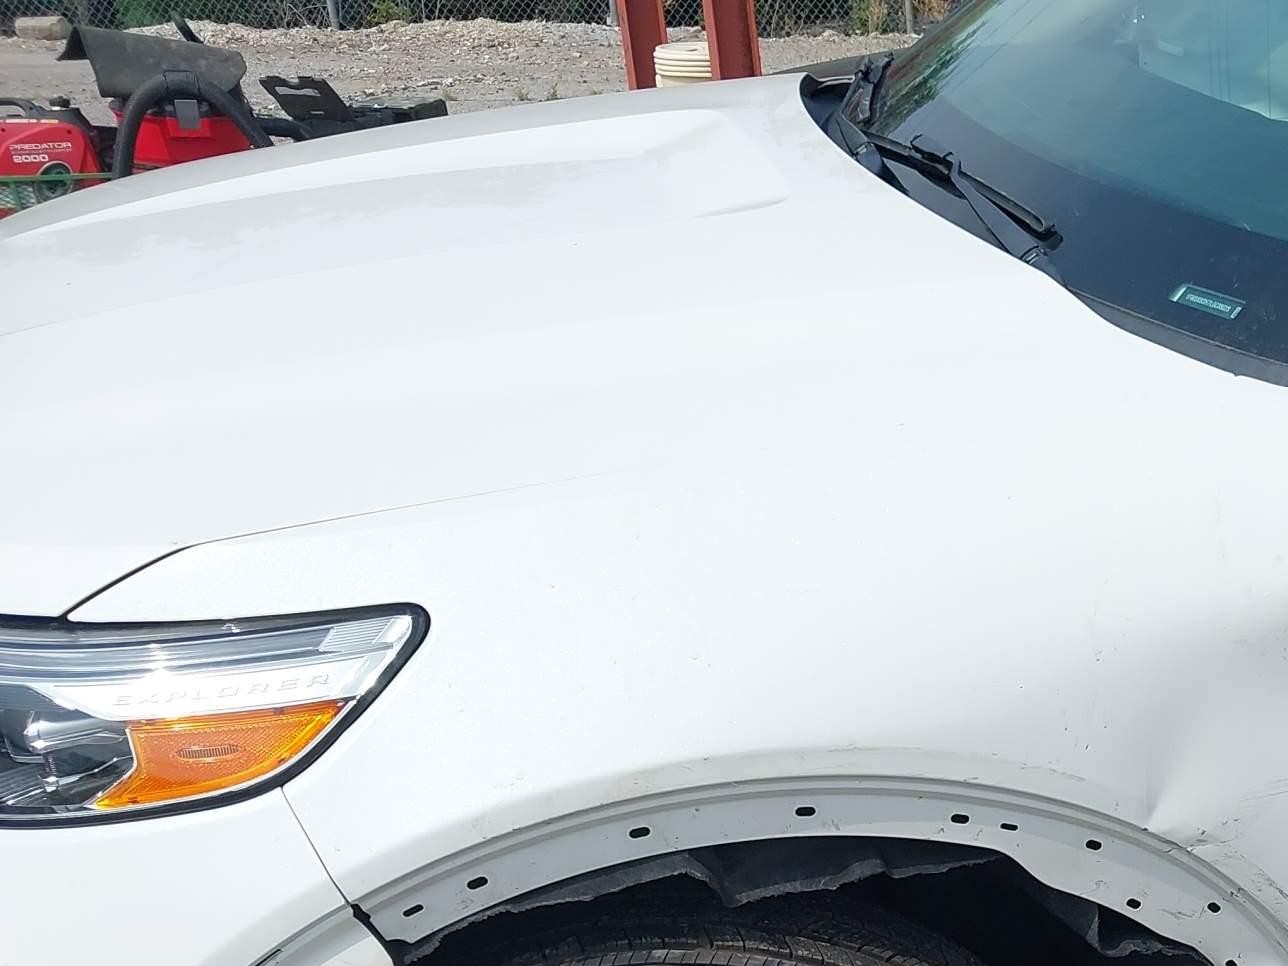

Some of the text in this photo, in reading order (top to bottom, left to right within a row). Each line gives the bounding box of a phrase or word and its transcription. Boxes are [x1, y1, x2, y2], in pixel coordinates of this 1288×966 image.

[9, 142, 72, 150] PREDATOR
[13, 154, 49, 163] 2000
[112, 673, 330, 705] EXPLORER
